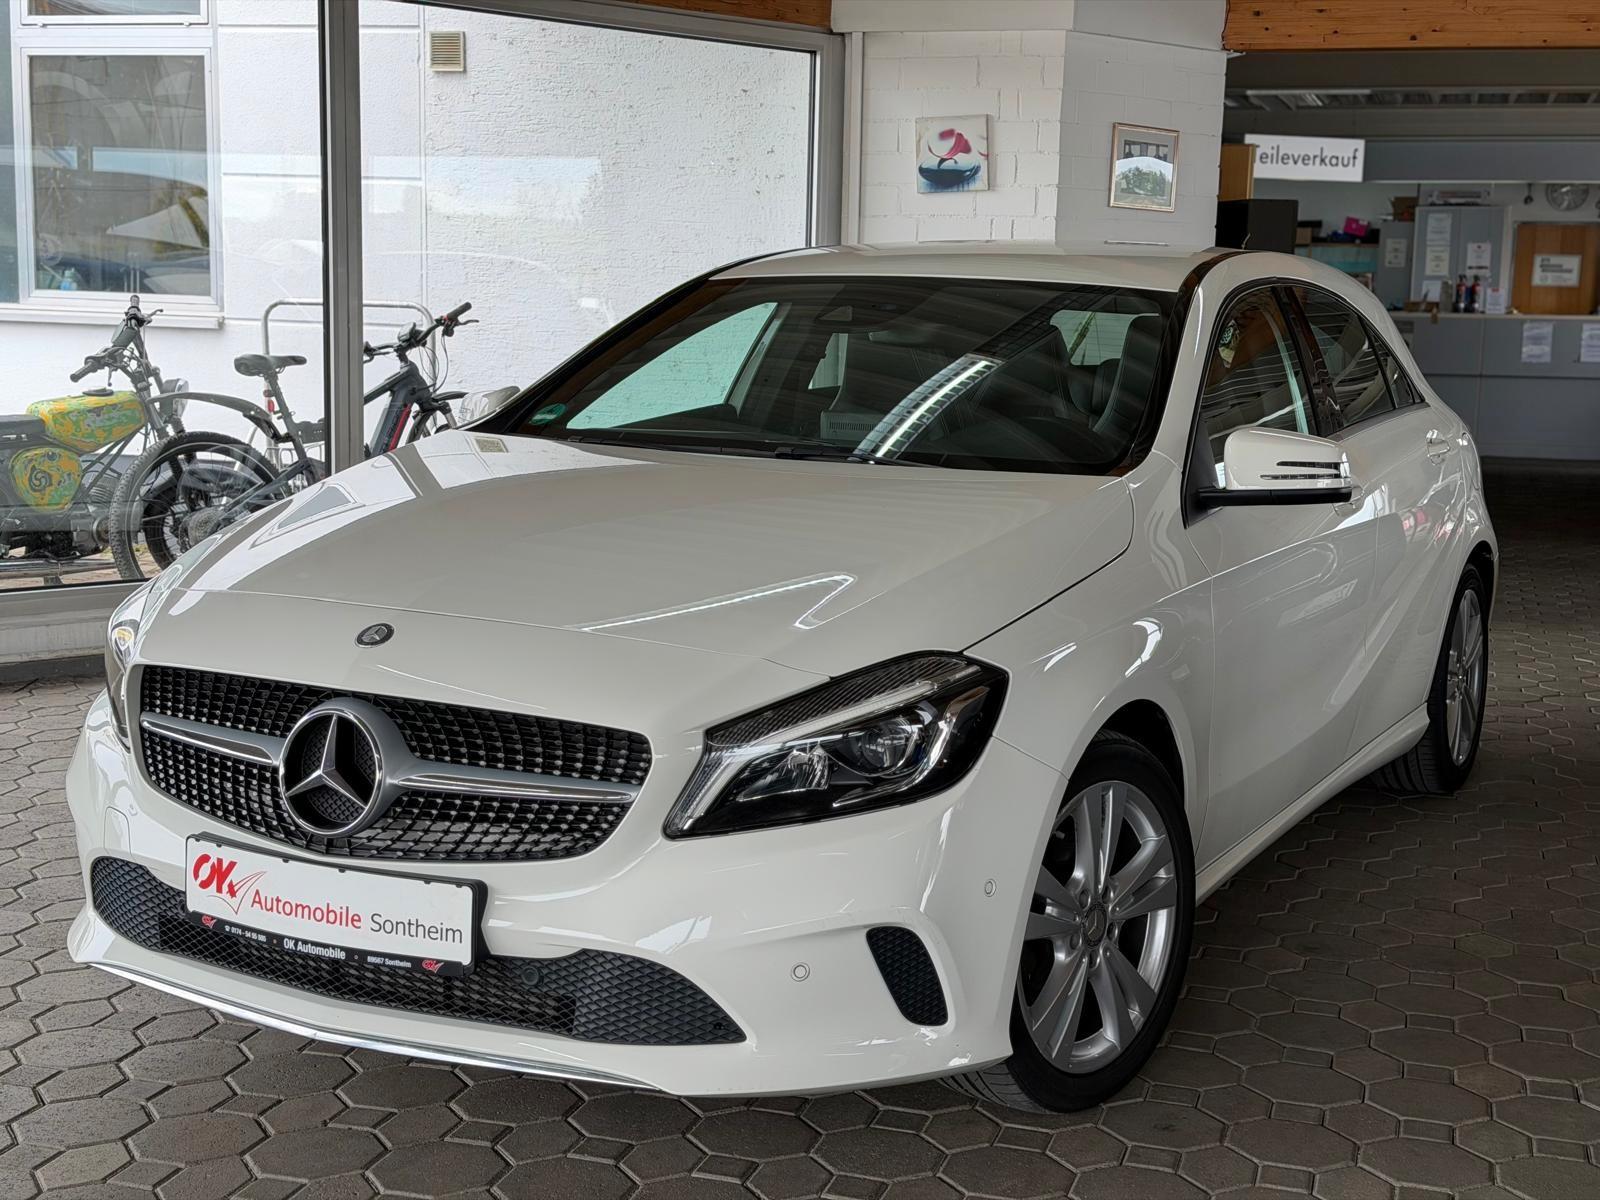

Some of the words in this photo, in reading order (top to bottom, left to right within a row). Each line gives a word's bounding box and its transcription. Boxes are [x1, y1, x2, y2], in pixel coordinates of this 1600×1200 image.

[192, 853, 238, 899] OK
[250, 888, 362, 929] Automobile
[370, 912, 463, 944] Sontheim
[283, 937, 296, 951] OK
[297, 940, 346, 960] Automobile
[384, 957, 412, 969] Sontheim
